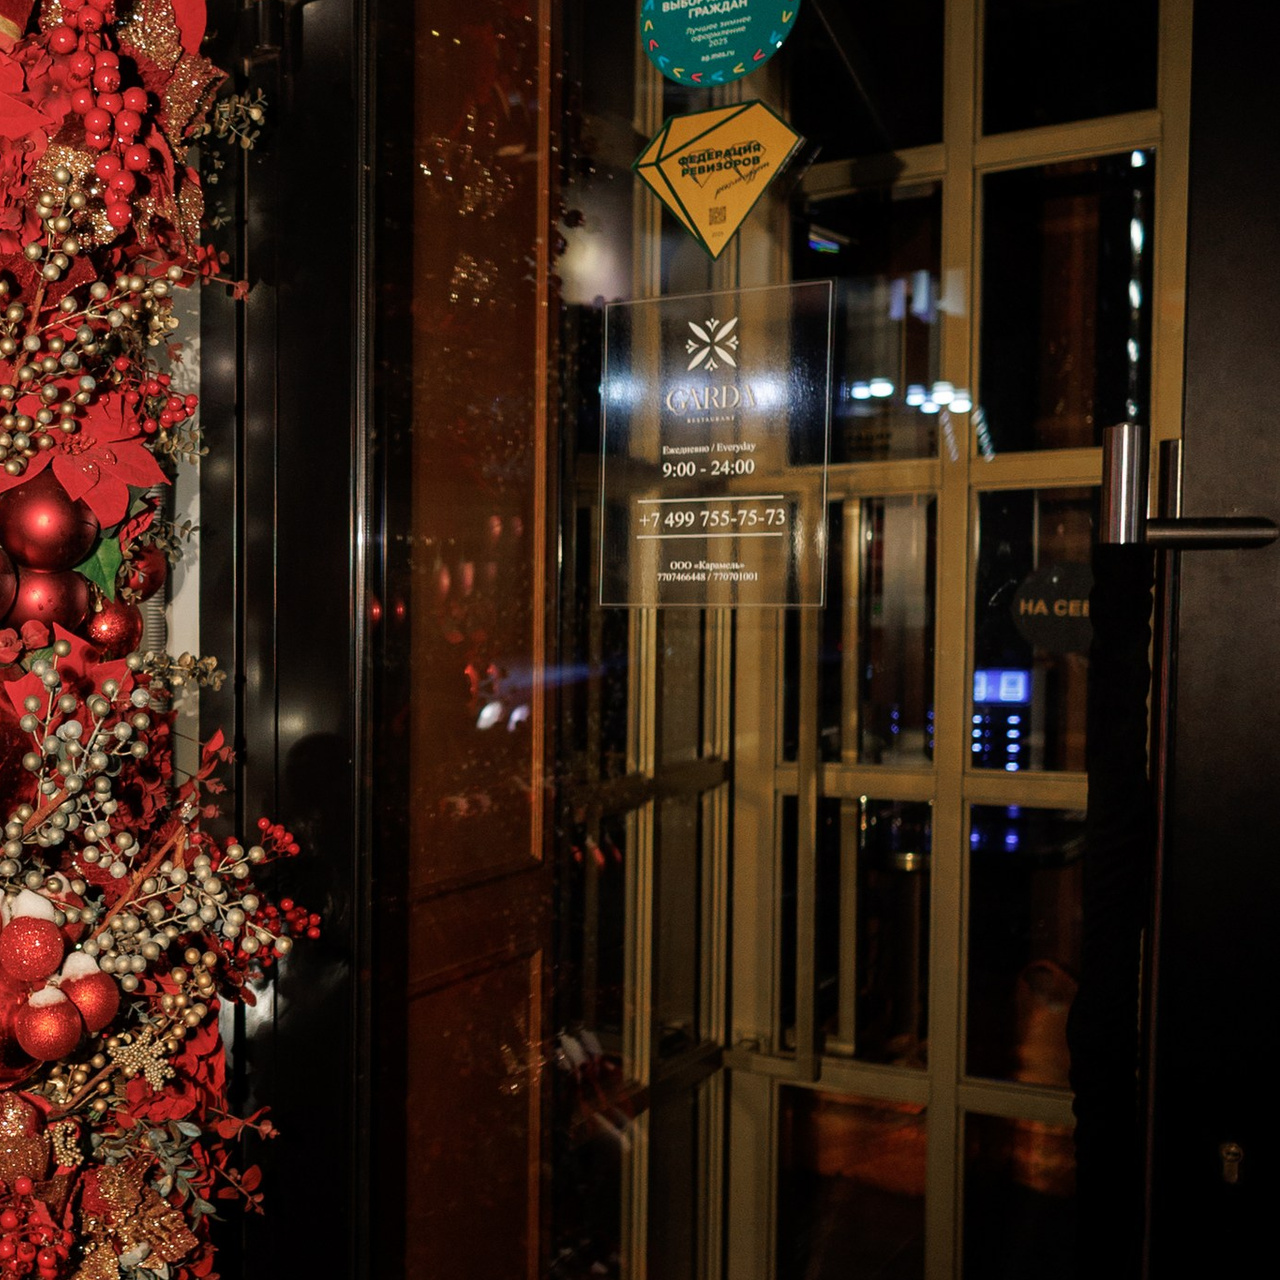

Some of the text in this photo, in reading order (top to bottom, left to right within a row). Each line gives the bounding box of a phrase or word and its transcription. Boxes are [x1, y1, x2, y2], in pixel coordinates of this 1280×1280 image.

[686, 15, 752, 35] Лучшее зимнее
[691, 26, 746, 43] оформление
[678, 142, 761, 165] ФЕДЕРАЦИЯ
[681, 156, 761, 177] РЕВИЗОРОВ
[666, 384, 758, 416] GARDA
[662, 446, 710, 456] Ежедневно
[716, 441, 756, 453] Everyday
[662, 461, 696, 478] 9:00
[710, 458, 755, 476] 24:00
[639, 508, 785, 528] +7 499 755-75-73
[670, 560, 745, 571] ООО «Карамель»
[713, 571, 758, 581] 770701001
[1019, 598, 1049, 616] НА
